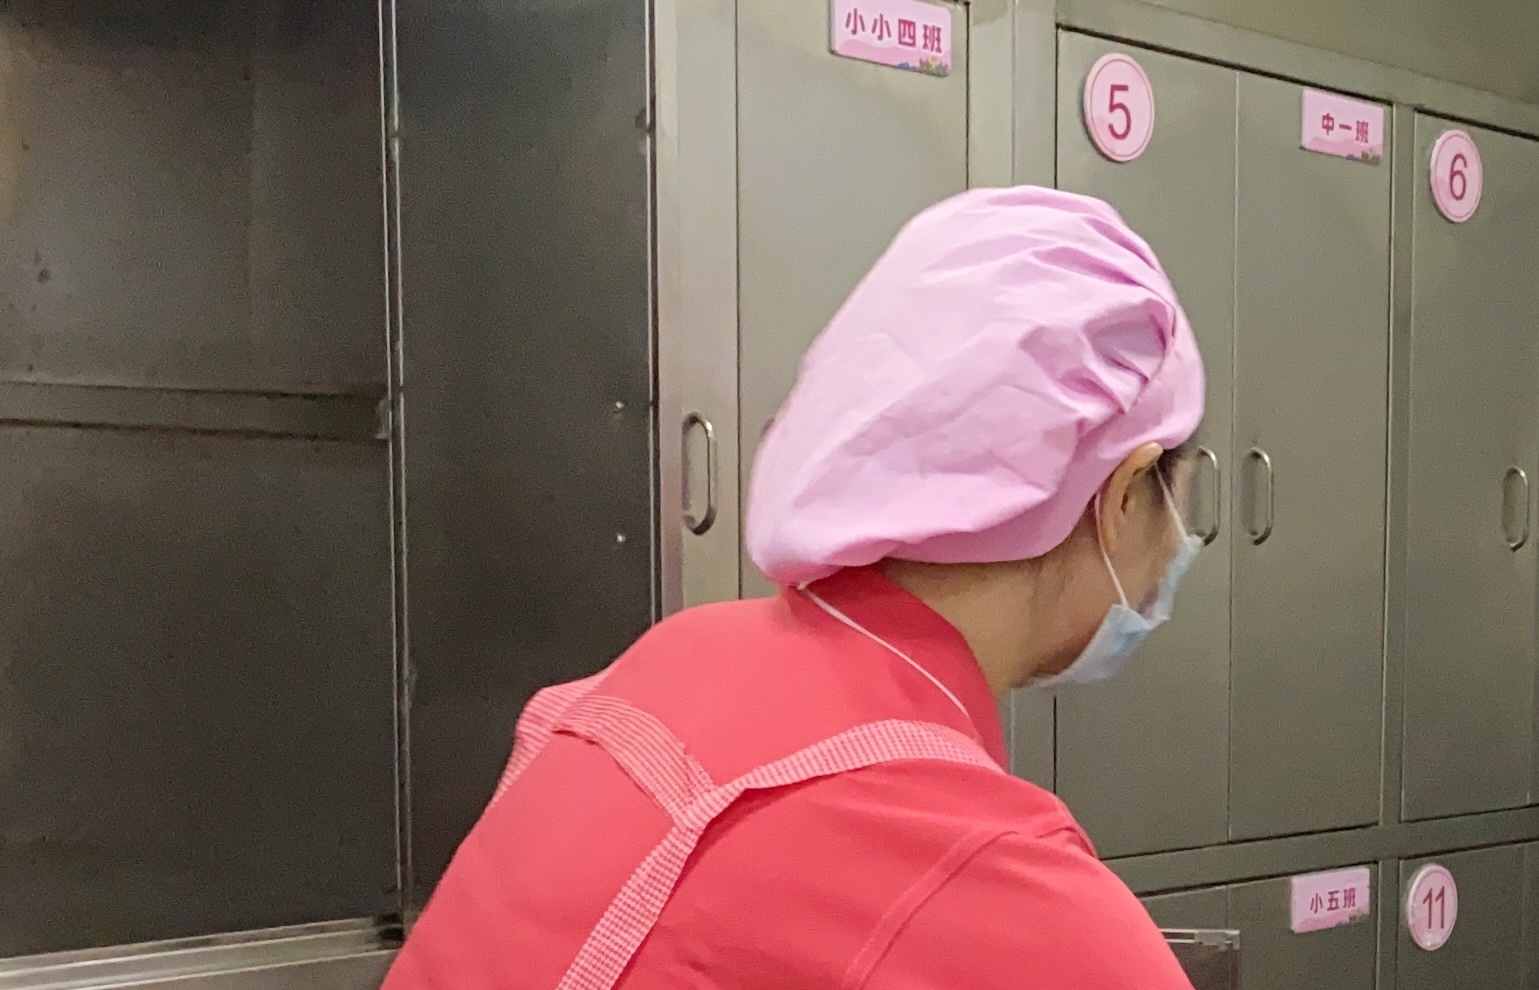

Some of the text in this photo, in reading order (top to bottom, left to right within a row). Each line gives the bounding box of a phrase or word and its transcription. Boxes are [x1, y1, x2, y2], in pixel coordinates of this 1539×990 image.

[844, 7, 943, 54] 小小四班
[1107, 83, 1132, 141] 5
[1321, 112, 1369, 144] 中一班
[1449, 153, 1468, 201] 6
[1309, 886, 1357, 914] 小五班
[1421, 885, 1446, 930] 11
